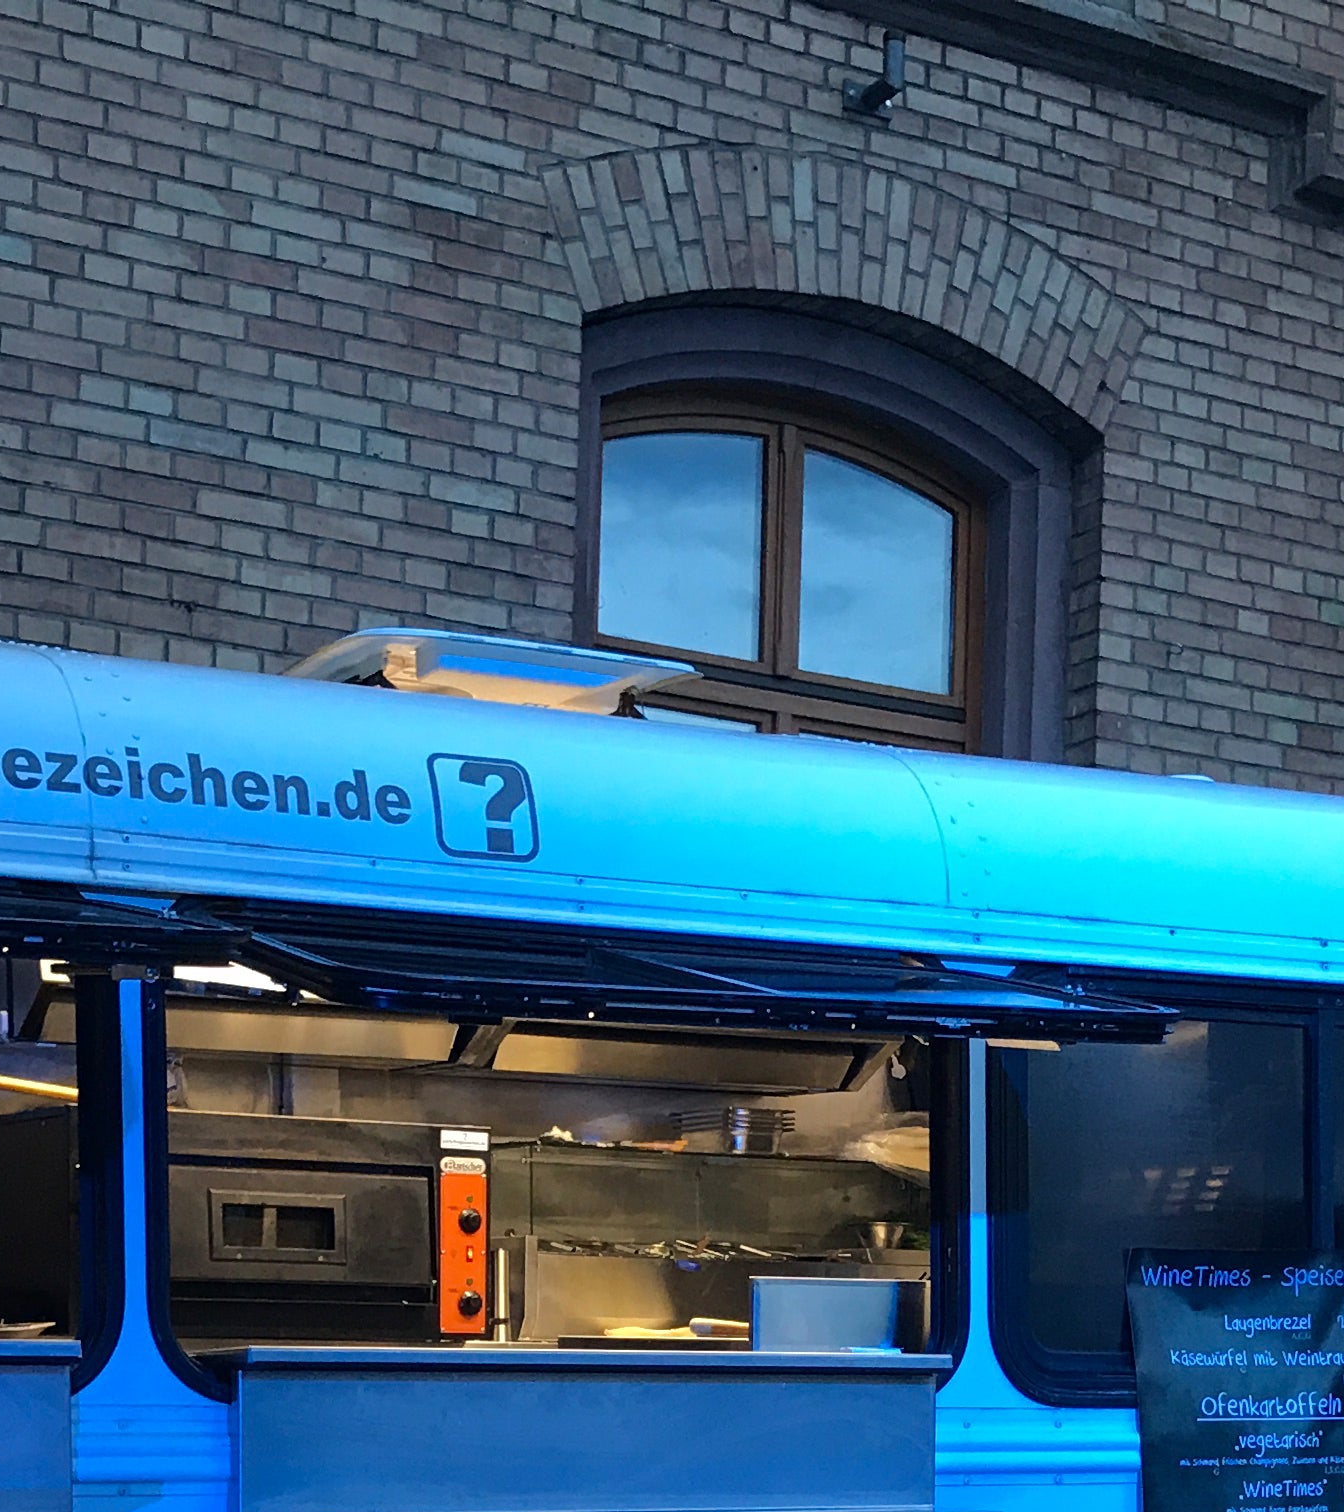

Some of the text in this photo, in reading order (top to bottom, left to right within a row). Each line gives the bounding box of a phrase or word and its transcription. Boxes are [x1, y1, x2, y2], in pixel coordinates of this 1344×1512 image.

[1141, 1265, 1251, 1287] WineTimes
[1224, 1314, 1312, 1338] Laugenbrezel
[1170, 1349, 1248, 1367] Käsewürfel
[1254, 1350, 1278, 1366] mit
[1201, 1392, 1342, 1417] Ofenkartoffeln
